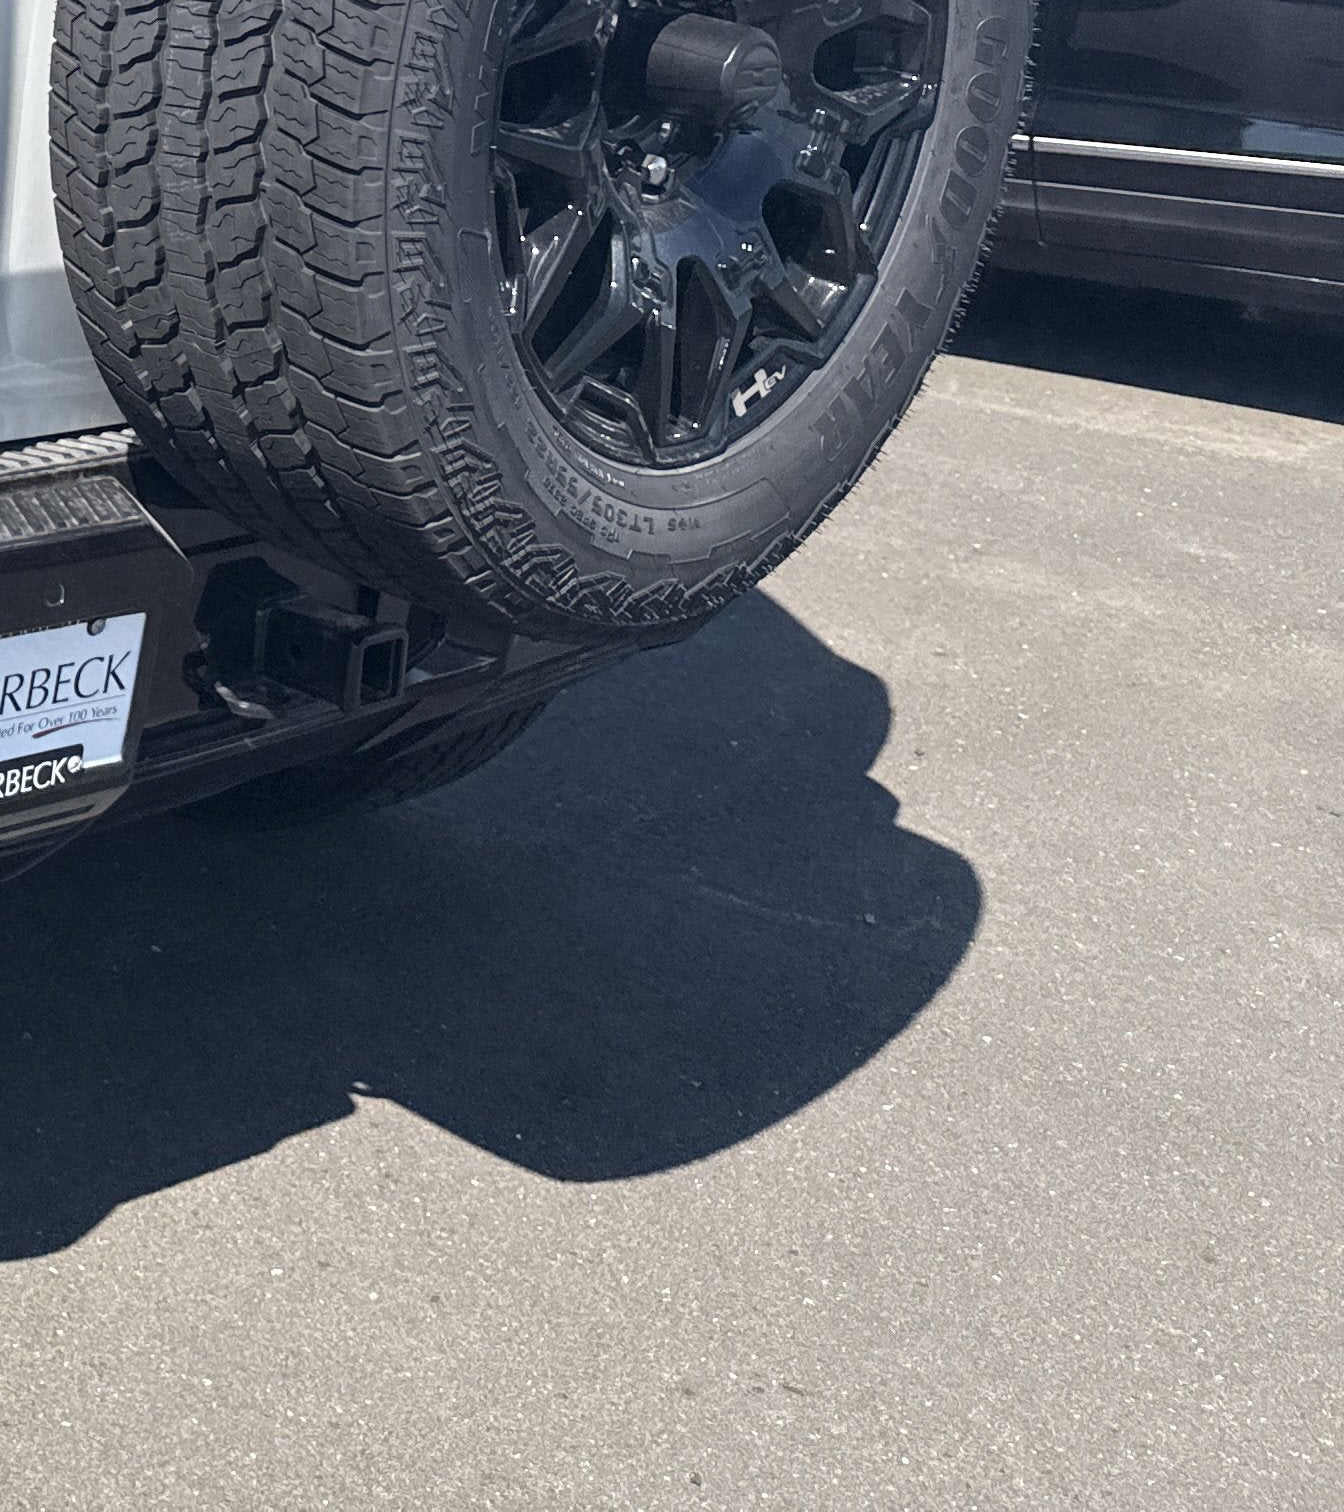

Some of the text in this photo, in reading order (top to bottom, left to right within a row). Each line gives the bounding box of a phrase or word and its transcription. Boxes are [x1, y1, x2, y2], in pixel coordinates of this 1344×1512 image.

[17, 719, 35, 735] For
[38, 714, 64, 730] Over
[68, 709, 88, 724] 100
[91, 703, 118, 719] Years
